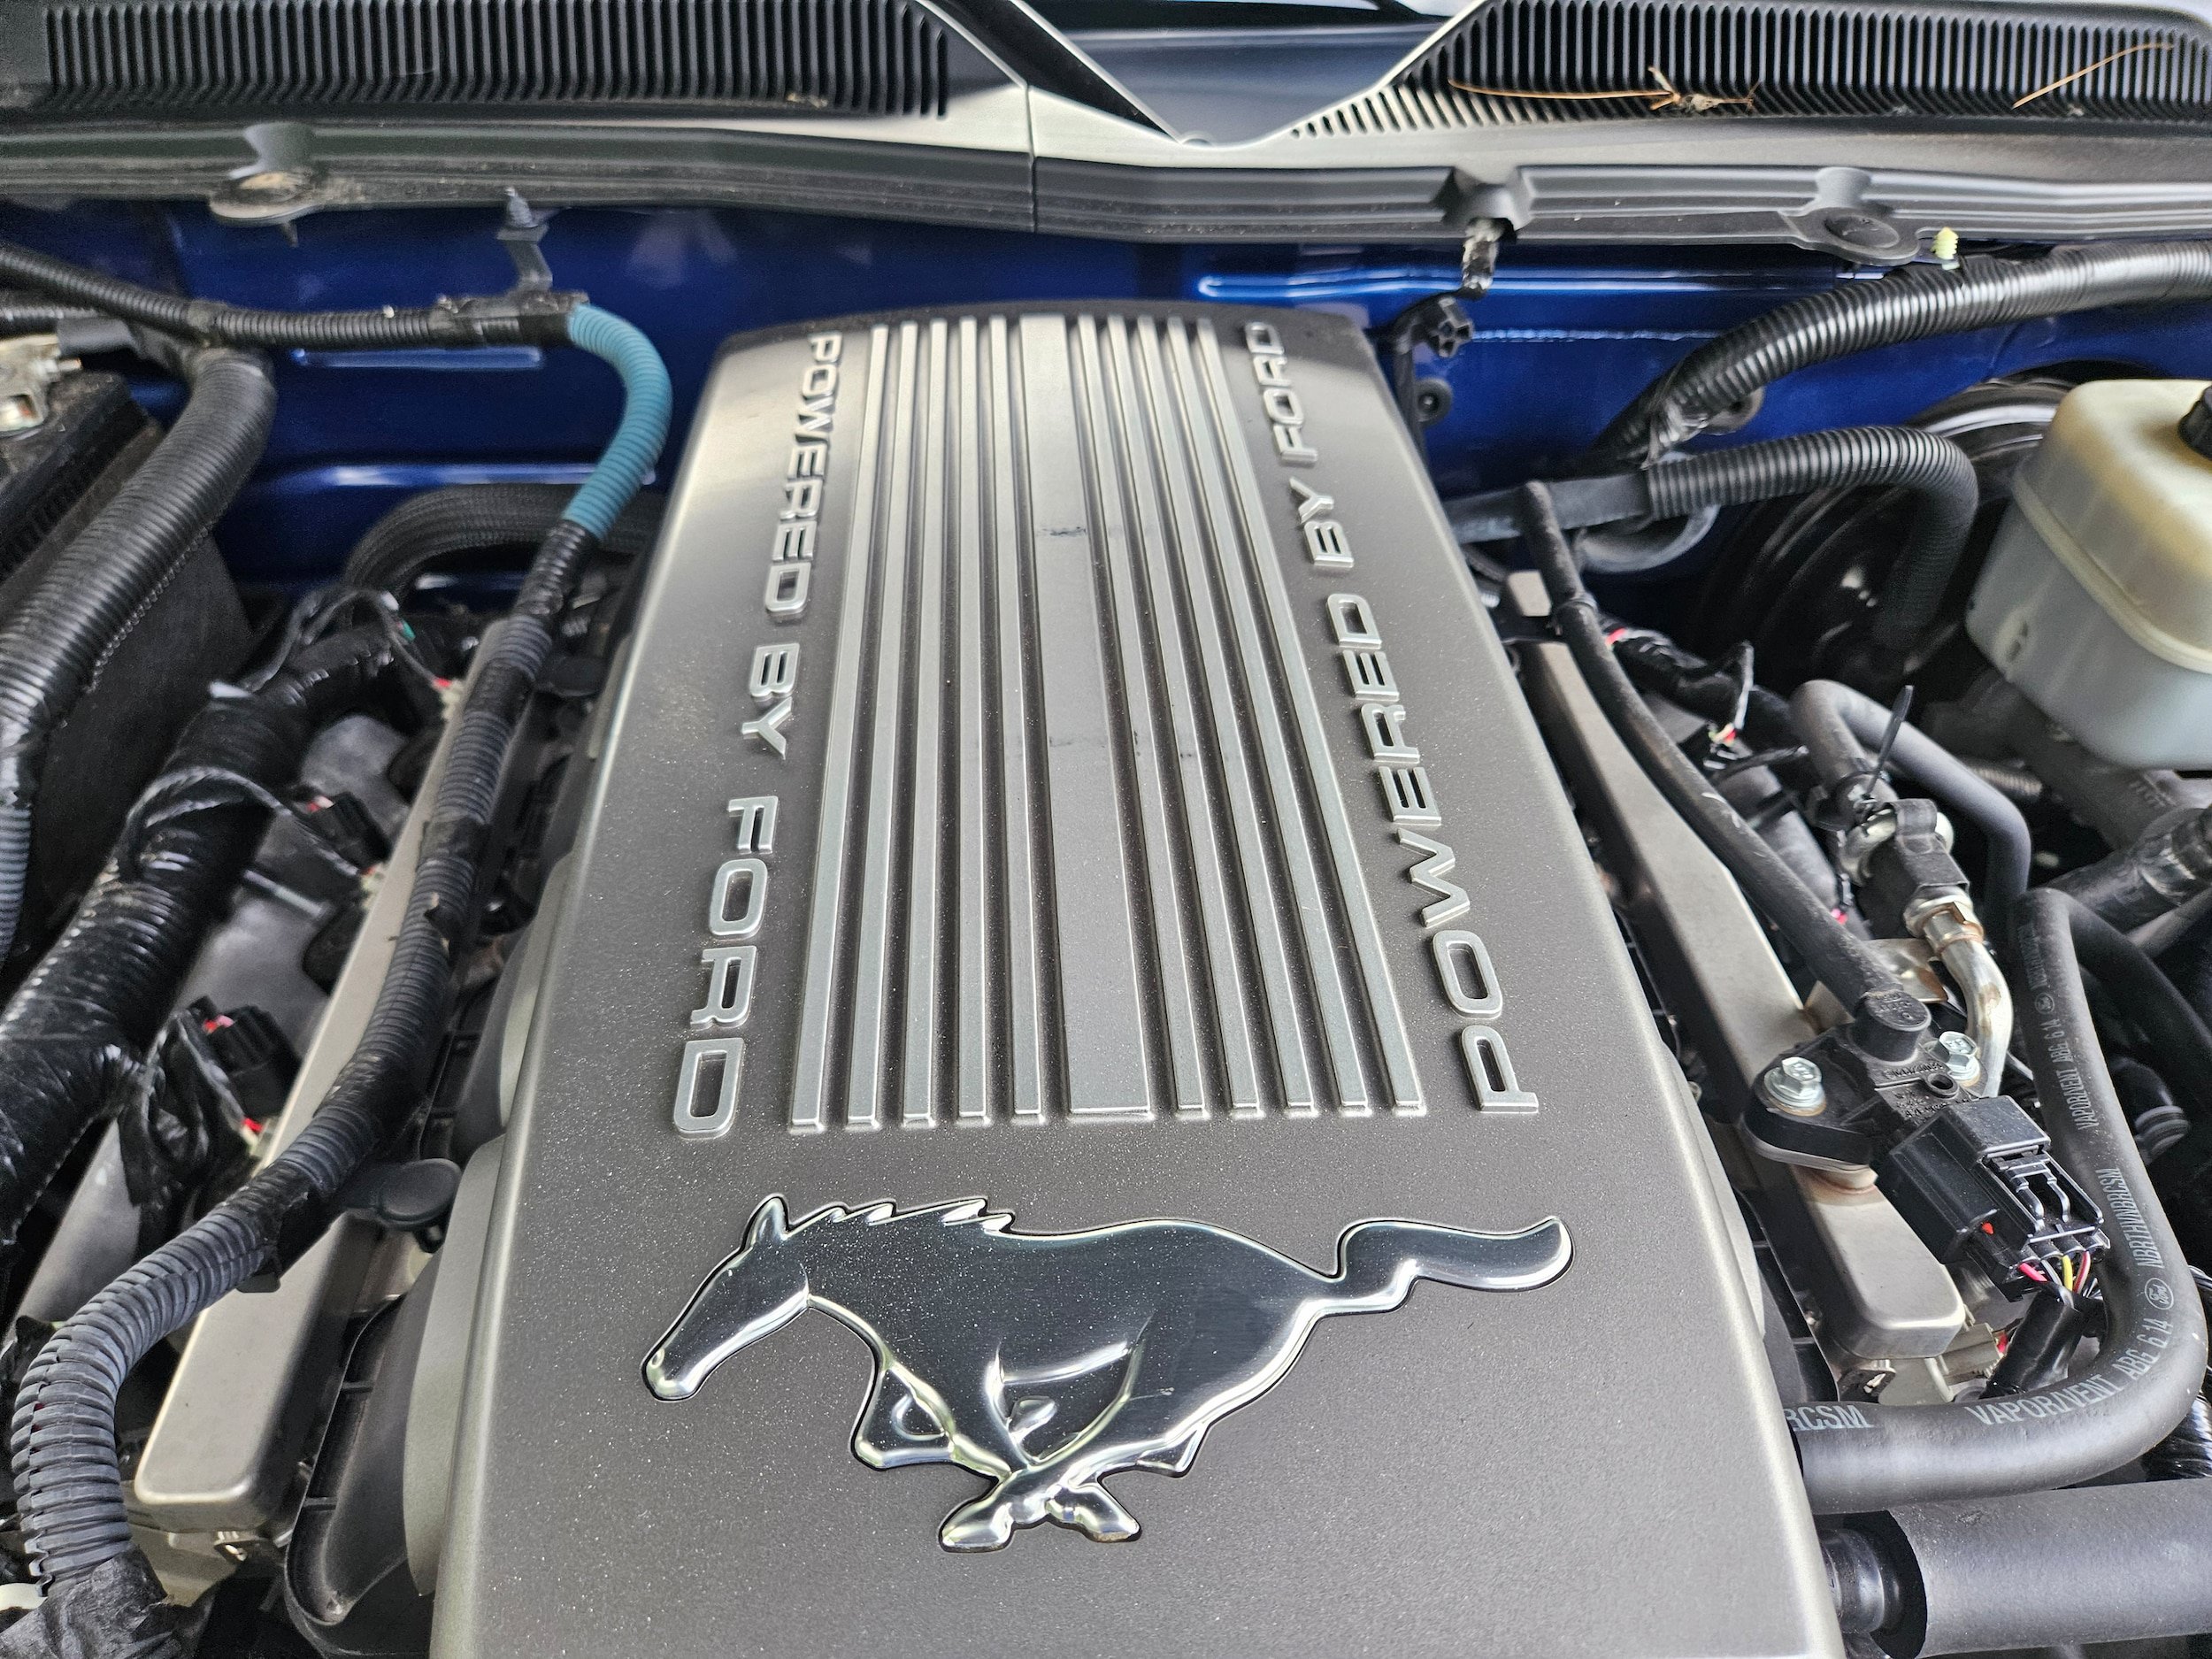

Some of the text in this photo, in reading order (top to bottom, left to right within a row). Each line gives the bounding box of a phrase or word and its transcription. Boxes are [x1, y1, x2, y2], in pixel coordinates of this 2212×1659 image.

[673, 332, 843, 1139] POWERED BY FORD
[1245, 321, 1539, 1113] POWERED BY FORD
[2047, 1041, 2074, 1063] ABG
[1963, 1374, 2124, 1425] VAPOR/VENT
[2111, 1348, 2161, 1381] ABG
[2147, 1281, 2171, 1307] Ford
